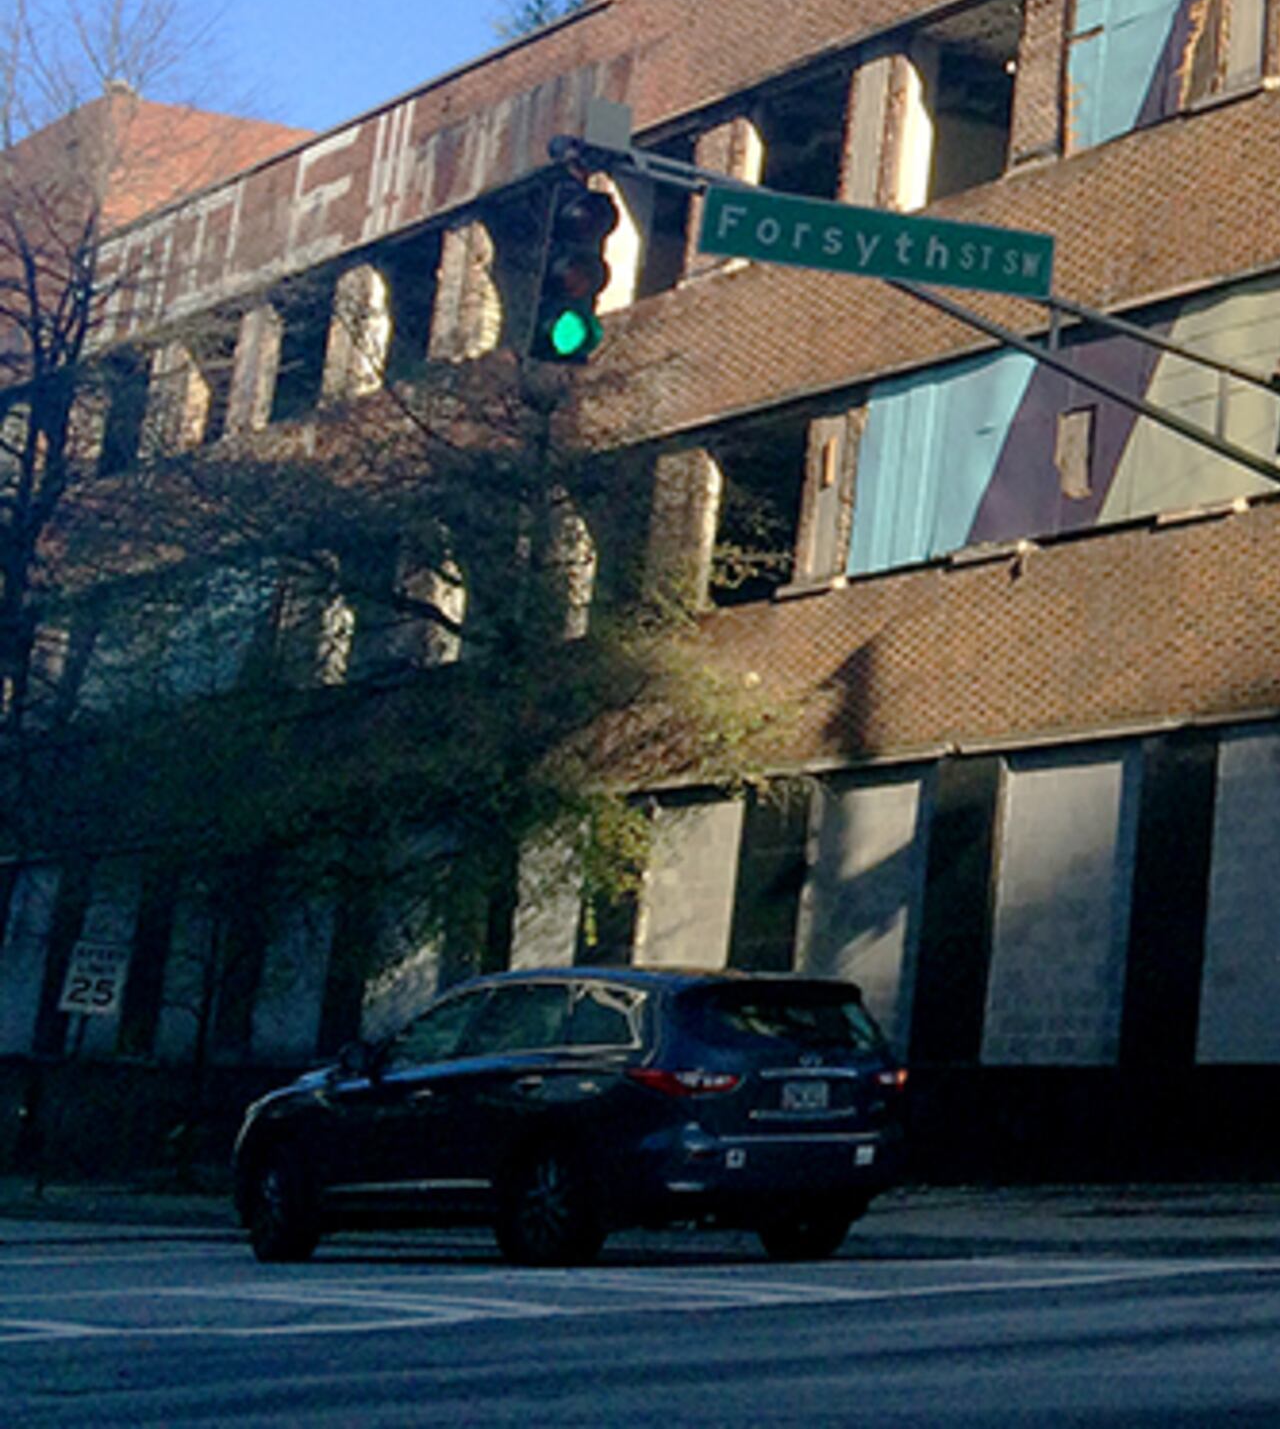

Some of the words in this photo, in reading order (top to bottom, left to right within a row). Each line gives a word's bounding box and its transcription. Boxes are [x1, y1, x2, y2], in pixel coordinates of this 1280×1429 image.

[716, 203, 948, 269] Forsyth
[960, 241, 993, 271] ST
[1002, 248, 1042, 279] SW
[68, 976, 115, 1006] 25
